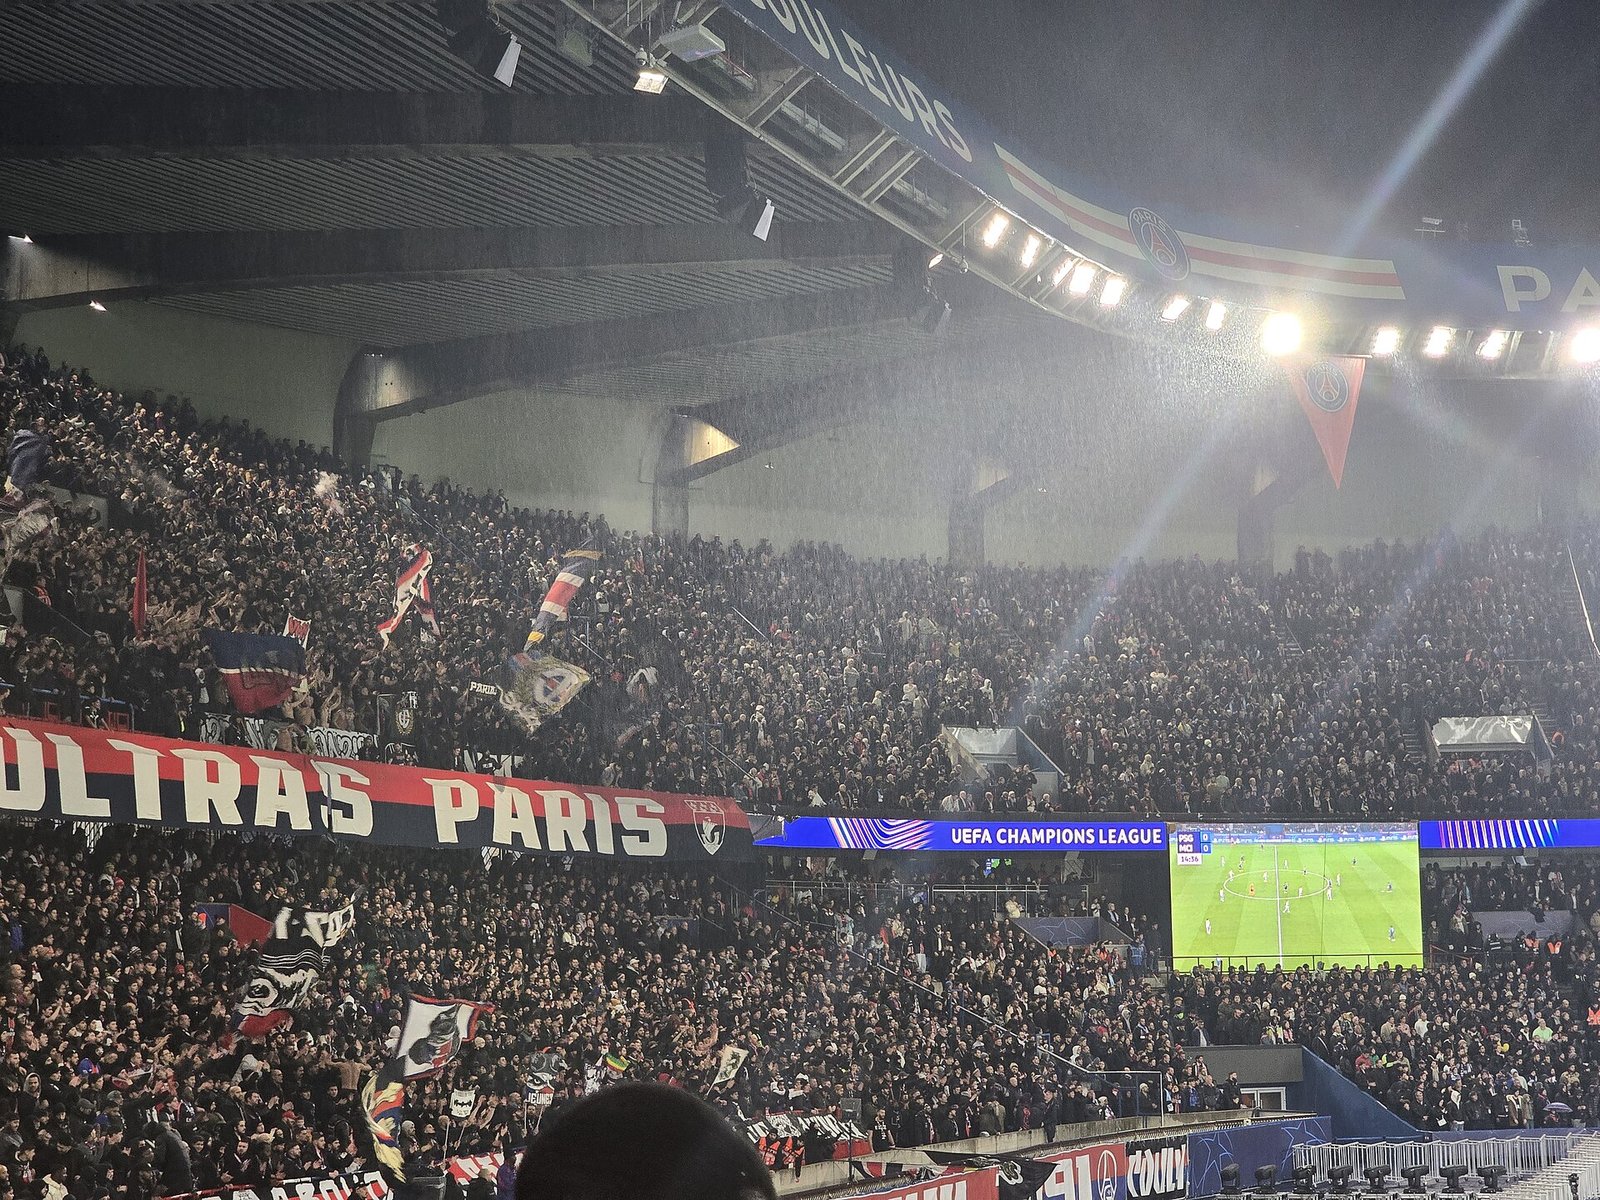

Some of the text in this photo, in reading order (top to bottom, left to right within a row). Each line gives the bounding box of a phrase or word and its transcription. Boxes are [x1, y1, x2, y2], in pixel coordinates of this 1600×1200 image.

[1132, 210, 1167, 232] PARIS
[0, 726, 668, 857] ULTRAS PARIS
[951, 828, 1162, 844] UEFA CHAMPIONS LEAGUE
[1178, 834, 1194, 843] PSG
[1202, 833, 1209, 842] 0
[1179, 844, 1209, 852] MCI 0
